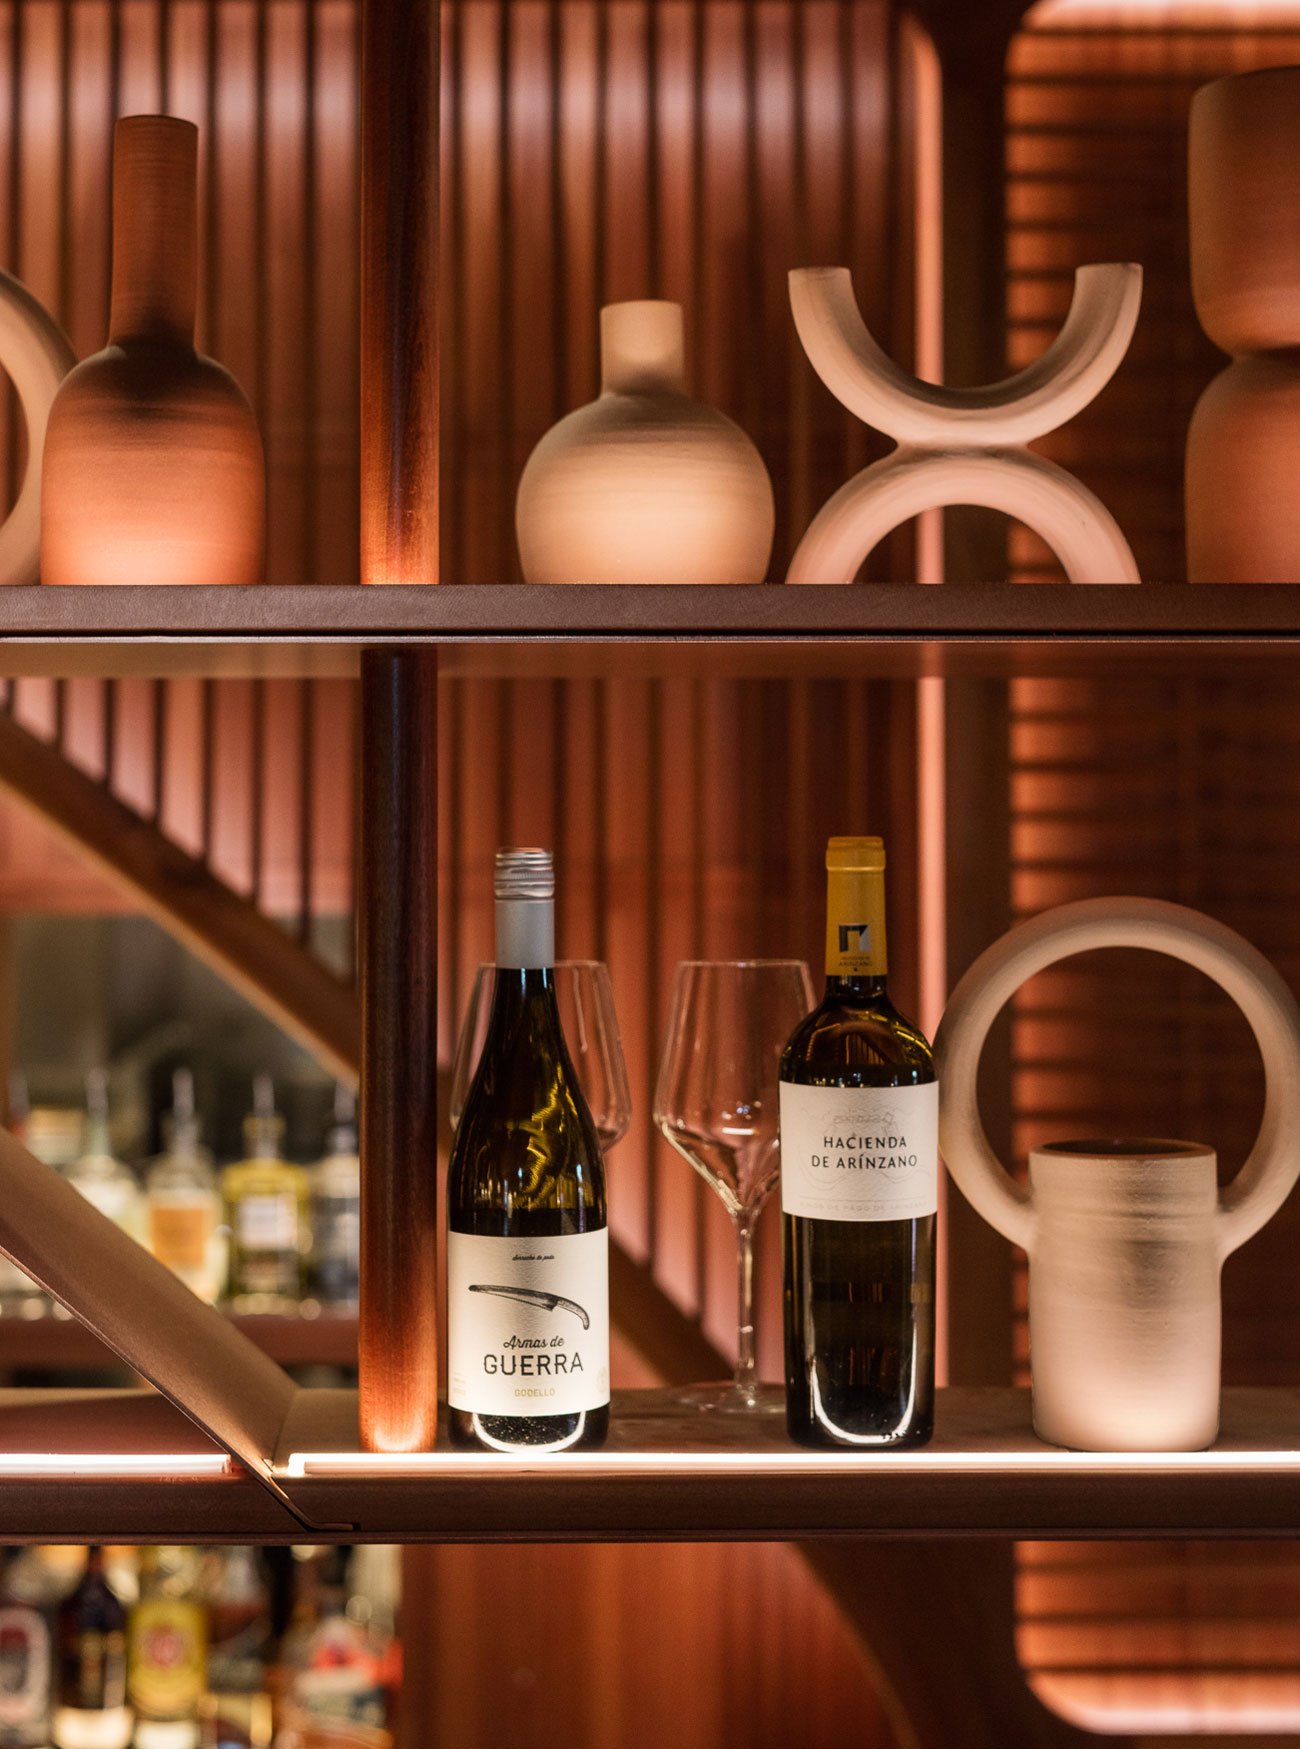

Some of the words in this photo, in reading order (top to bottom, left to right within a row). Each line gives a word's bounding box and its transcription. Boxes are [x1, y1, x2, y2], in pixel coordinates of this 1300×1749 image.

[823, 1135, 908, 1149] HACIENDA
[811, 1155, 830, 1168] DE
[836, 1153, 918, 1169] ARÍNZANO
[503, 1334, 547, 1350] Armas
[550, 1335, 565, 1347] de
[483, 1351, 585, 1376] GUERRA
[514, 1387, 556, 1398] GODELLO
